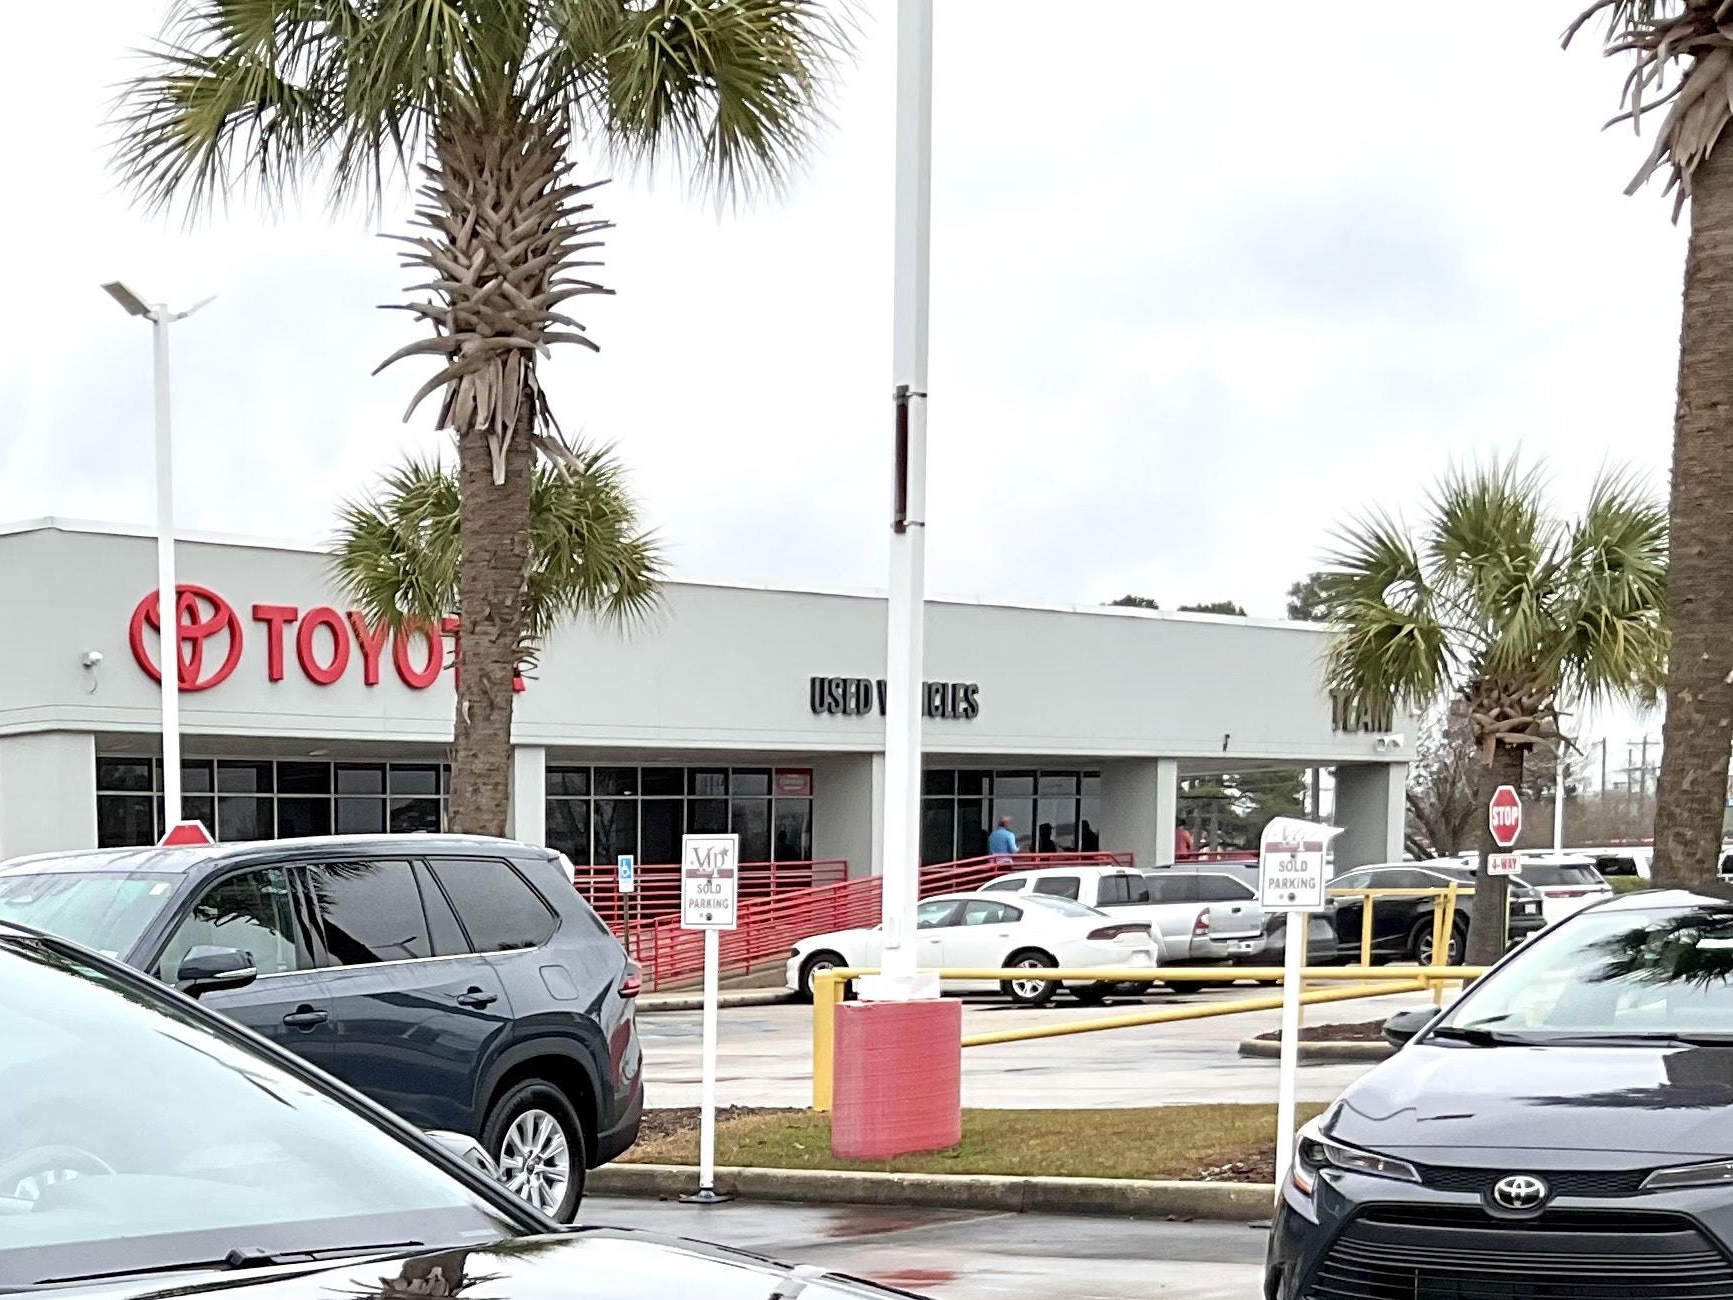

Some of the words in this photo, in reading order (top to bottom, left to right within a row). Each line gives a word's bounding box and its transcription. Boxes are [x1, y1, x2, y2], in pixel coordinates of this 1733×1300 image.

[810, 677, 874, 715] USED
[1492, 806, 1518, 826] STOP
[1278, 860, 1308, 872] SOLD
[1491, 858, 1517, 870] 4-WAY
[696, 883, 722, 894] SOLD
[1268, 877, 1316, 889] PARKING
[688, 898, 729, 909] PARKING
